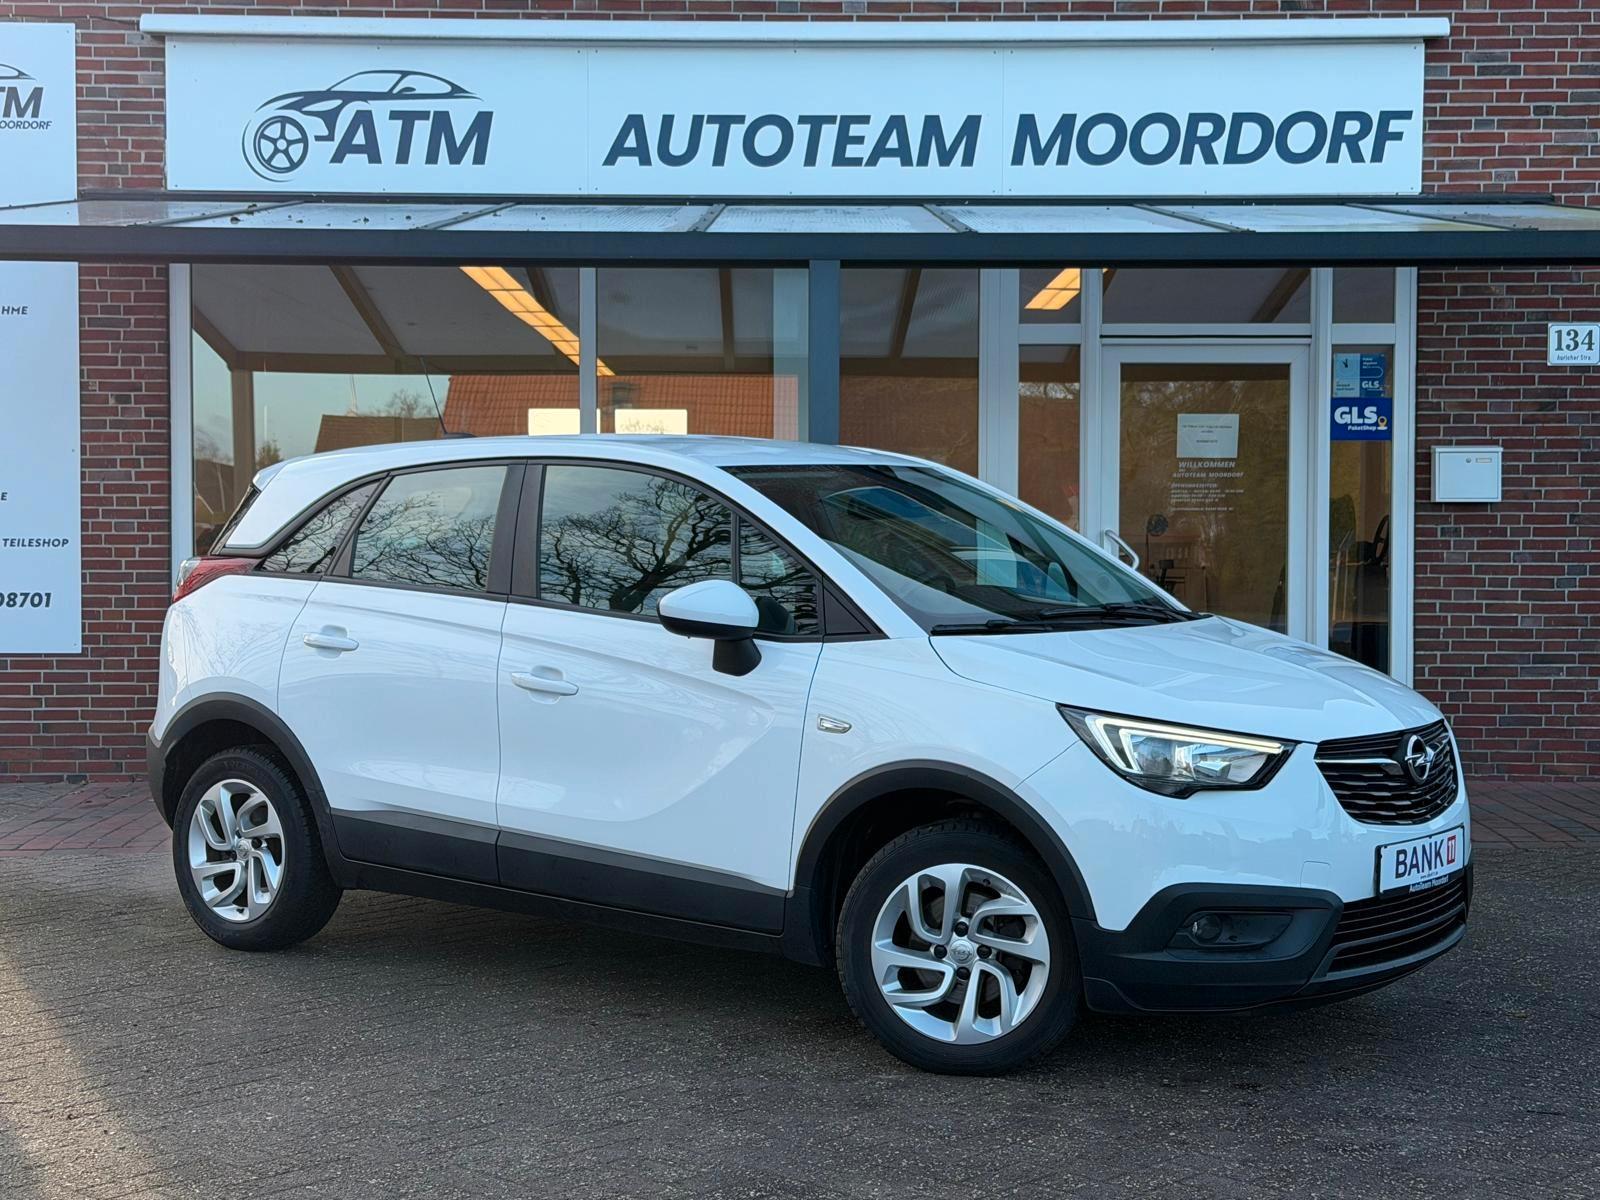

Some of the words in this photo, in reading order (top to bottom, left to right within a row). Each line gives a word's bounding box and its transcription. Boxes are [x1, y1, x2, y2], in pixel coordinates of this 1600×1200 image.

[0, 86, 44, 118] M
[329, 109, 494, 165] ATM
[601, 113, 982, 168] AUTOTEAM
[1010, 110, 1414, 166] MOORDORF
[1554, 329, 1595, 351] 134
[1362, 380, 1380, 389] GLS
[1334, 406, 1378, 424] GLS
[2, 538, 69, 548] TEILESHOP
